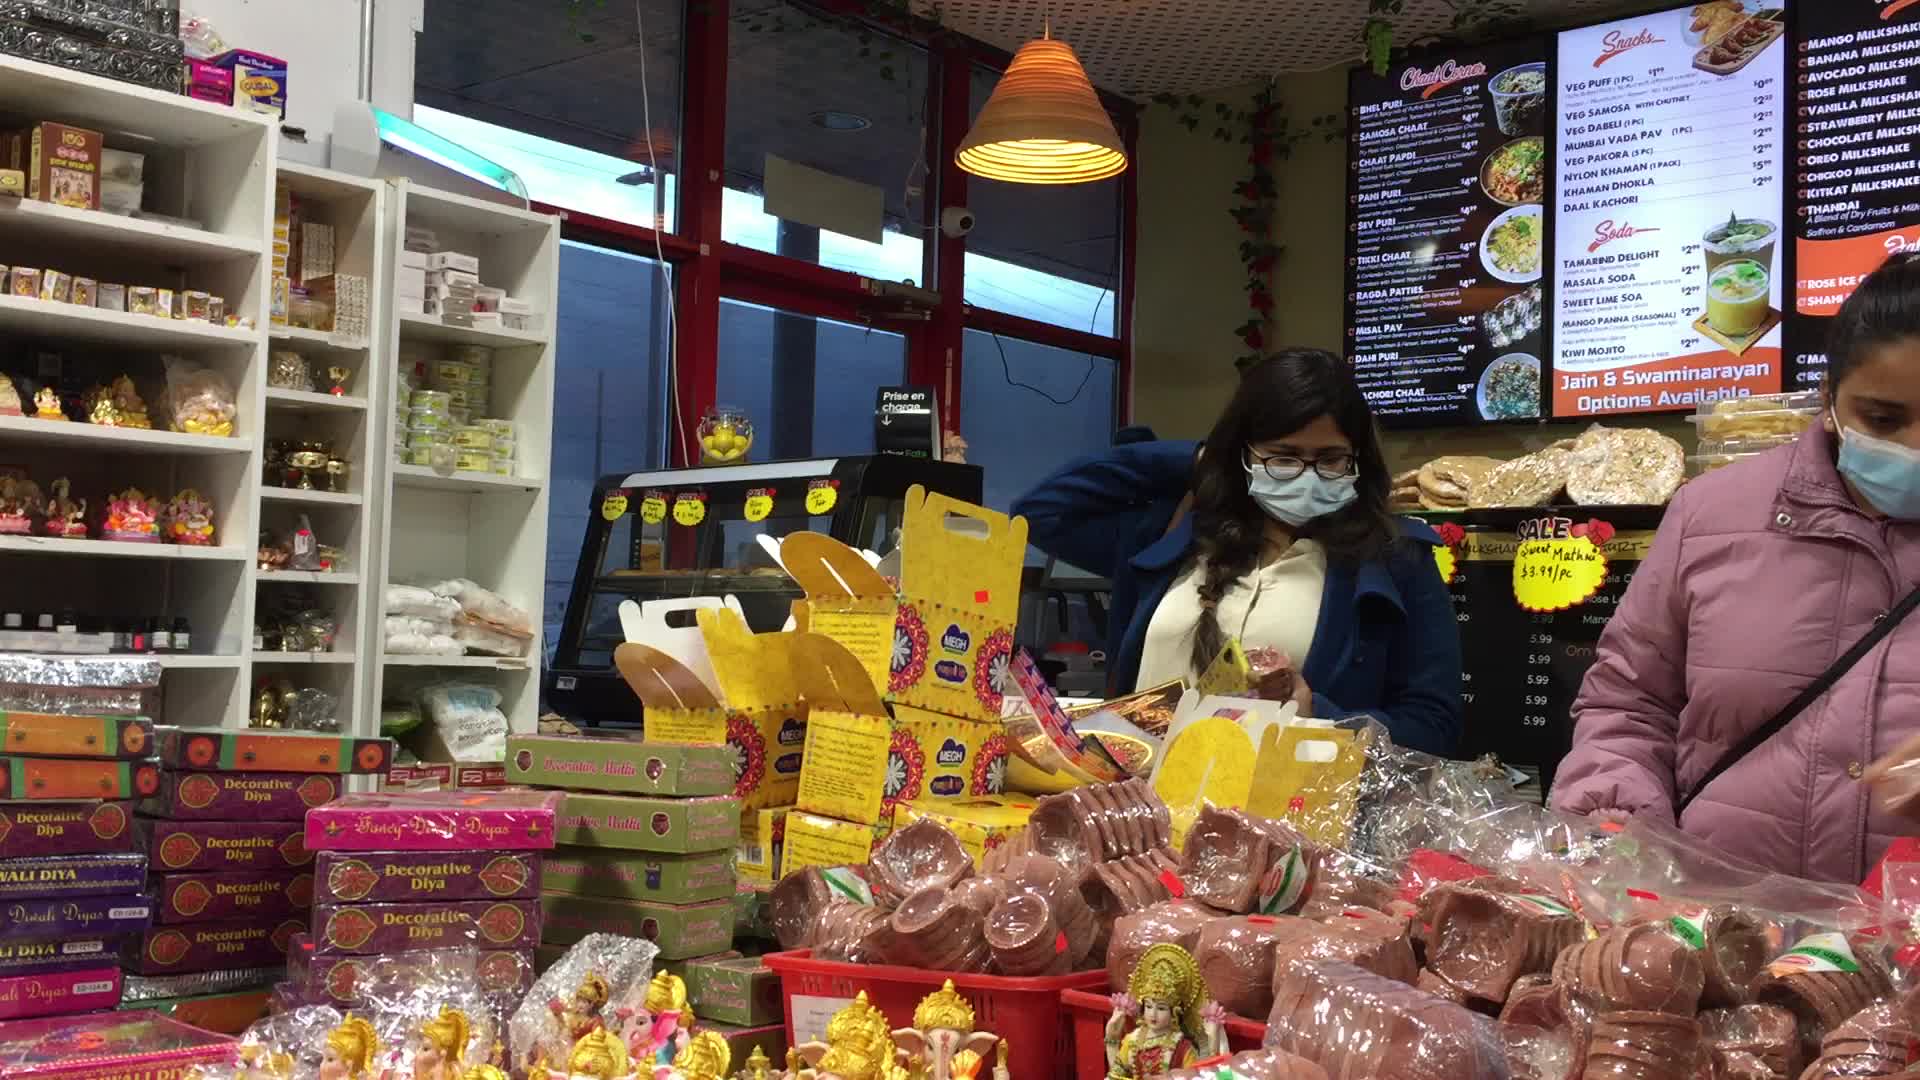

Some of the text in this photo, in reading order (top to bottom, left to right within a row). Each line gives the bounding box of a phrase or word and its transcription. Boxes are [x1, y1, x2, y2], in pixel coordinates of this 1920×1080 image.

[1601, 28, 1660, 53] Snacks
[1808, 34, 1854, 50] MANGO
[1808, 50, 1859, 66] BANANA
[1440, 59, 1486, 83] Corner
[1808, 65, 1866, 83] AVOCADO
[1565, 81, 1586, 93] VEG
[1588, 77, 1612, 89] PUFF
[1808, 75, 1907, 100] ROSE MILKSHAKE
[1360, 100, 1402, 115] BHEL PURI
[1565, 109, 1586, 121] VEG
[1588, 104, 1631, 118] SAMOSA
[1808, 100, 1858, 116] VANILLA
[1565, 126, 1586, 137] VEG
[1588, 120, 1622, 134] DABELI
[1808, 113, 1884, 132] STRAWBERRY
[1360, 122, 1429, 141] SAMOSA CHAAT
[1564, 139, 1606, 152] MUMBAI
[1608, 133, 1638, 145] VADA
[1640, 129, 1663, 140] PAV
[1807, 131, 1873, 149] CHOCOLATE
[1359, 152, 1417, 168] CHAAT PAPDI
[1564, 156, 1585, 167] VEG
[1587, 150, 1629, 164] PAKORA
[1807, 143, 1910, 166] OREO MILKSHAKE
[1564, 169, 1599, 183] NYLON
[1600, 163, 1648, 177] KHAMAN
[1807, 160, 1915, 183] CHICKOO MILKSHAKE
[1564, 178, 1655, 197] KHAMAN DHOKLA
[1807, 175, 1920, 199] KITKAT MILKSHAKE
[1358, 189, 1401, 202] PANI PURI
[1563, 195, 1638, 213] DAAL KACHORI
[1807, 201, 1860, 216] THANDAI
[1850, 210, 1866, 222] Dry
[1867, 207, 1892, 218] Fruits
[1358, 218, 1396, 230] SEV PURI
[1594, 219, 1633, 243] Soda
[1807, 227, 1837, 238] Saffron
[1846, 220, 1896, 233] Cardamom
[1357, 251, 1411, 265] TIKKI CHAAT
[1563, 255, 1615, 269] TAMARIND
[1618, 250, 1660, 264] DELIGHT
[1563, 277, 1605, 289] MASALA
[1607, 273, 1636, 283] SODA
[1807, 276, 1857, 289] ROSE ICE
[1356, 285, 1423, 300] RAGDA PATTIES
[1562, 298, 1595, 309] SWEET
[1596, 295, 1618, 305] LIME
[1622, 293, 1643, 302] SOA
[1807, 295, 1844, 306] SHAHI
[1562, 318, 1596, 329] MANGO
[1598, 315, 1629, 325] PANNA
[1632, 312, 1677, 323] (SEASONAL)
[1356, 324, 1403, 336] MISAL PAV
[1355, 352, 1399, 363] DAHI PURI
[1562, 349, 1586, 359] KIWI
[1587, 345, 1626, 356] MOJITO
[1561, 363, 1770, 390] Jain & Swaminarayan
[883, 391, 925, 401] Prise en
[1395, 388, 1425, 399] CHAAT
[1577, 386, 1751, 413] Options Available
[1516, 517, 1572, 540] SALE
[1521, 543, 1552, 558] Sweet
[1520, 564, 1573, 583] $3.99/pc
[944, 635, 968, 650] MEGH
[1530, 634, 1553, 644] 5.99
[1528, 654, 1551, 664] 5.99
[1527, 675, 1550, 685] 5.99
[1525, 695, 1548, 705] 5.99
[1523, 716, 1546, 726] 5.99
[939, 750, 963, 761] MEGH
[225, 778, 293, 790] Decorative
[244, 791, 272, 804] Diya
[17, 811, 84, 823] Decorative
[36, 823, 64, 837] Diya
[464, 815, 510, 840] Diyas
[207, 837, 274, 849] Decorative
[225, 849, 253, 861] Diya
[40, 869, 77, 881] DIYA
[384, 862, 472, 877] Decorative
[216, 880, 280, 895] Decorative
[411, 877, 446, 892] Diya
[234, 893, 262, 906] Diya
[63, 903, 104, 926] Diyas
[383, 910, 470, 925] Decorative
[196, 928, 266, 943] Decorative
[408, 924, 443, 939] Diya
[18, 943, 56, 957] DIYA
[216, 941, 245, 954] Diya
